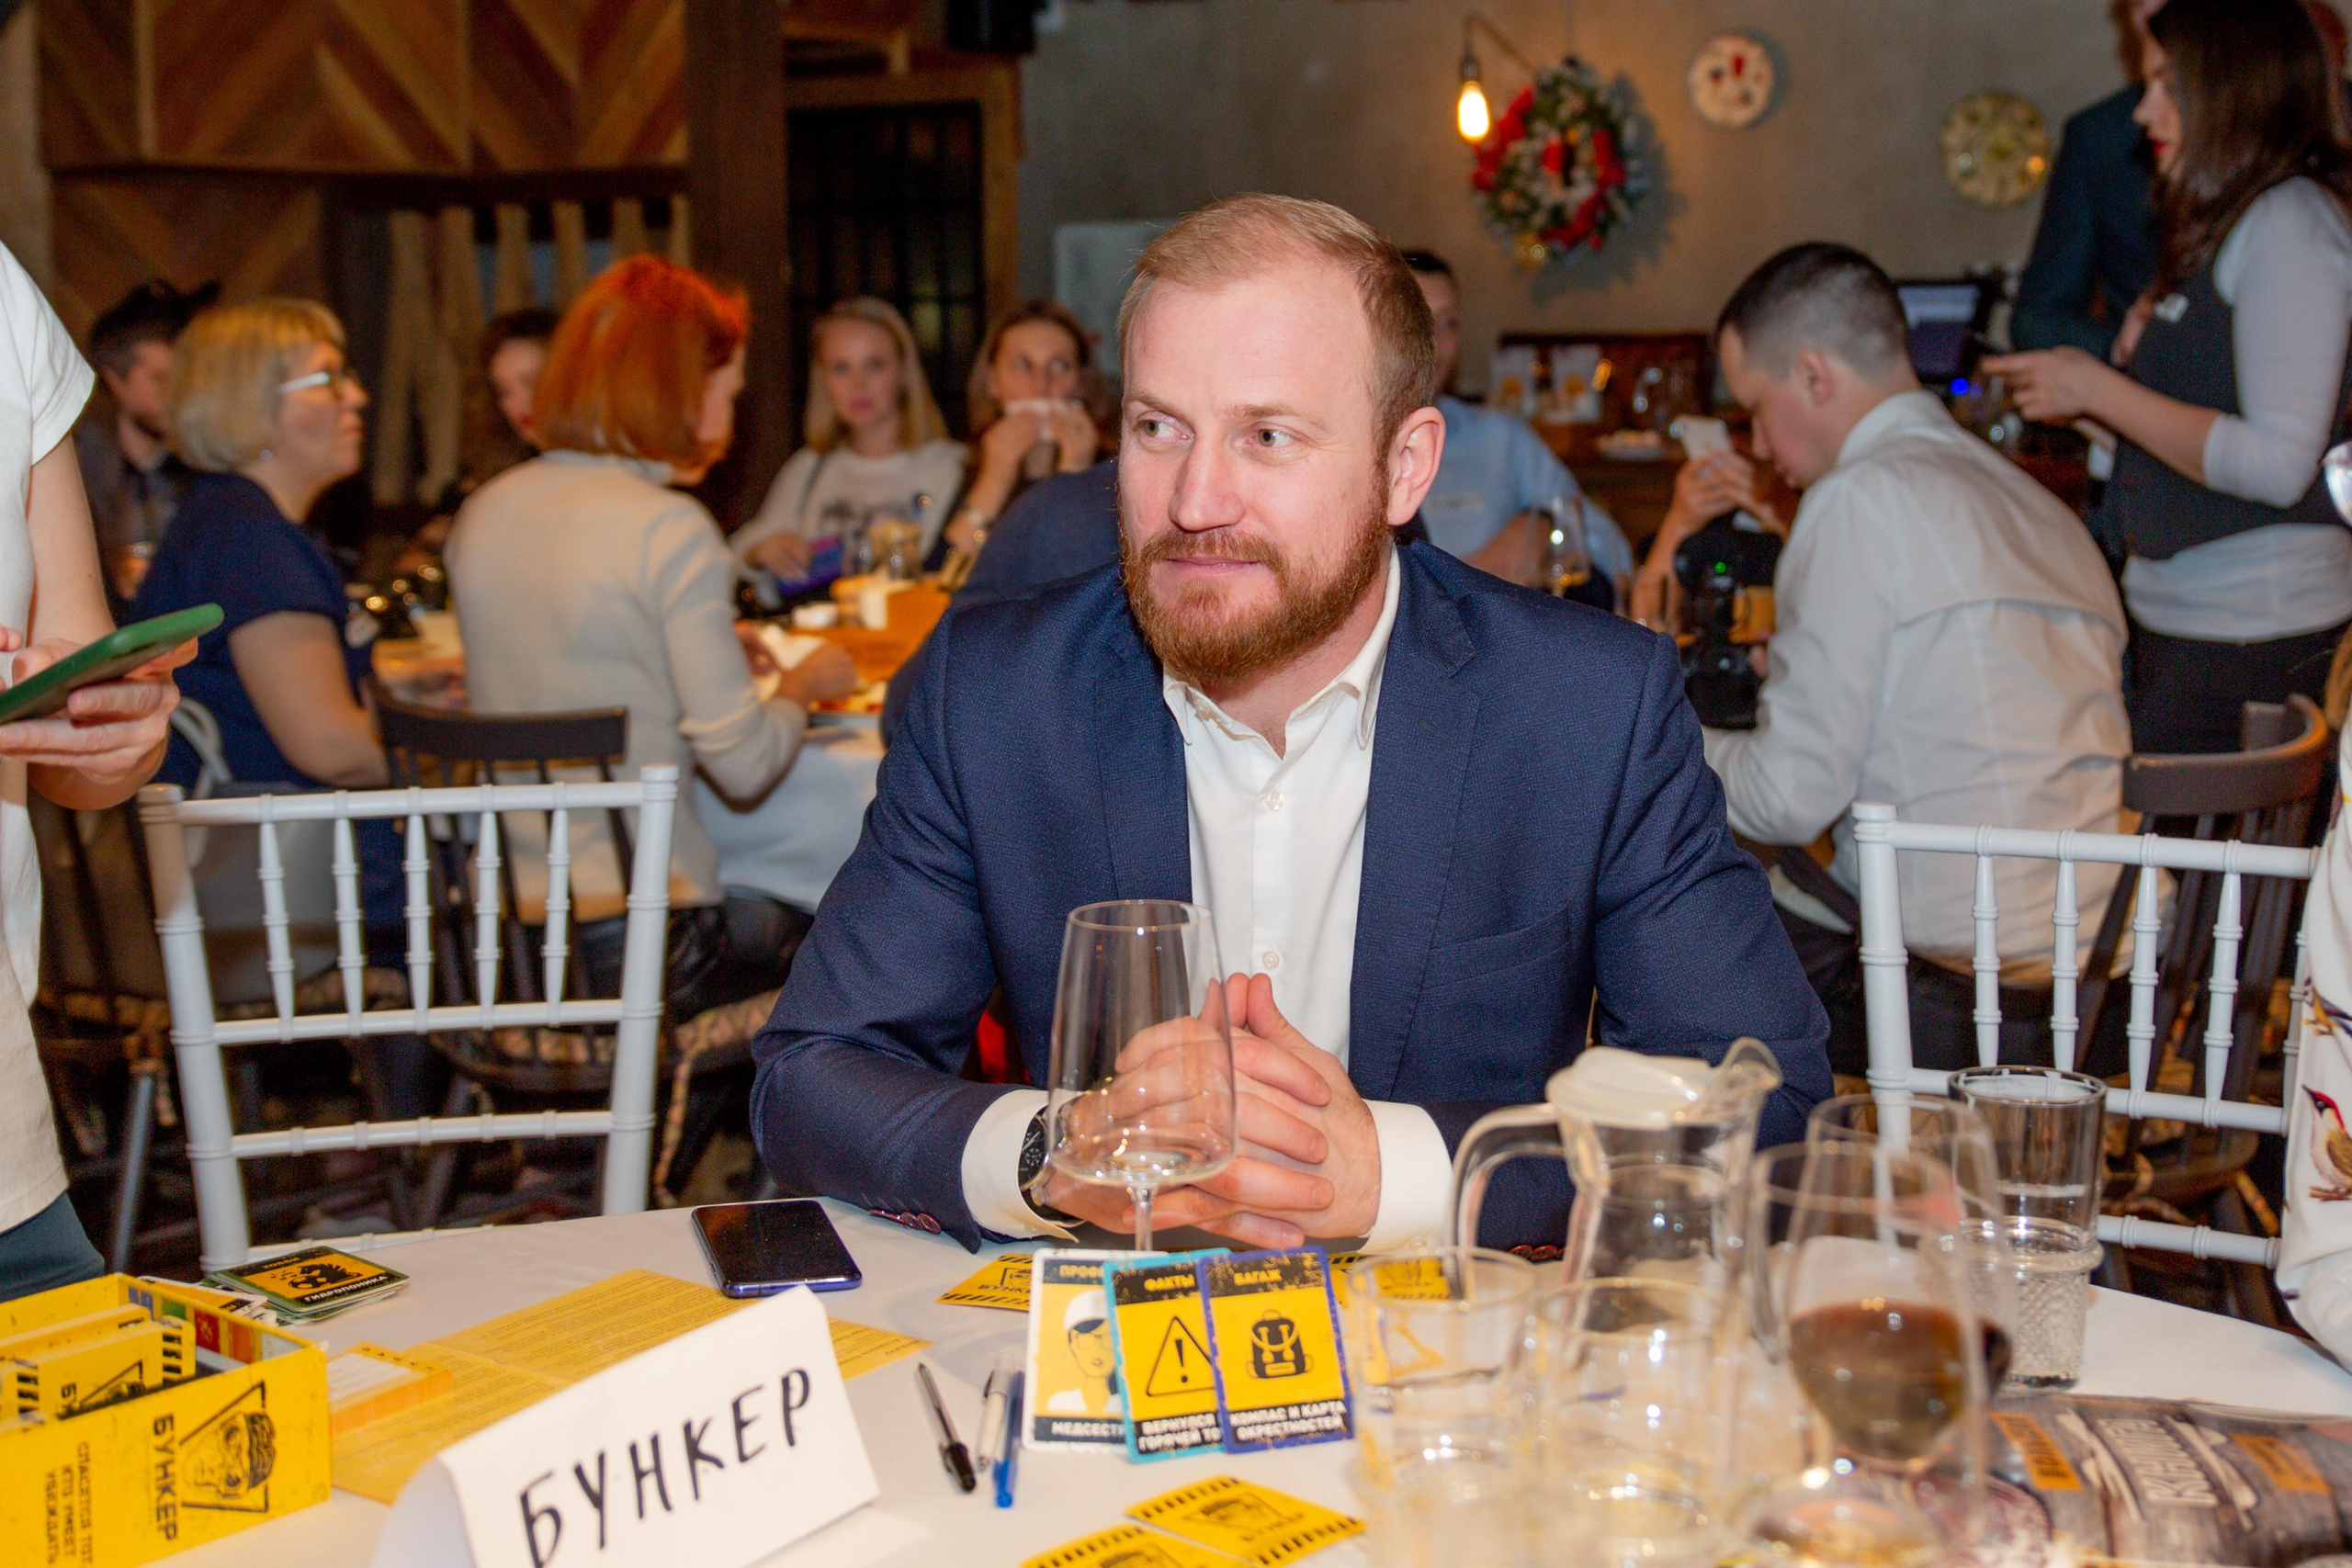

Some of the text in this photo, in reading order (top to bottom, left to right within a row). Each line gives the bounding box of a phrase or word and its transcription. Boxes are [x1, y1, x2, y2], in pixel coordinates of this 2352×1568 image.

[304, 1275, 388, 1303] ГИДРОПОНИКА
[1143, 1273, 1196, 1292] ФАКТЫ
[1233, 1268, 1283, 1286] БАГАЖ
[1141, 1413, 1217, 1436] ВЕРНУЛСЯ
[1228, 1399, 1348, 1427] КОМПАС И КАРТА
[1137, 1428, 1202, 1451] ГОРЯЧЕЙ
[1236, 1415, 1344, 1441] ОКРЕСТНОСТЕЙ
[153, 1415, 177, 1540] БУНКЕР
[517, 1367, 813, 1568] БУНКЕР
